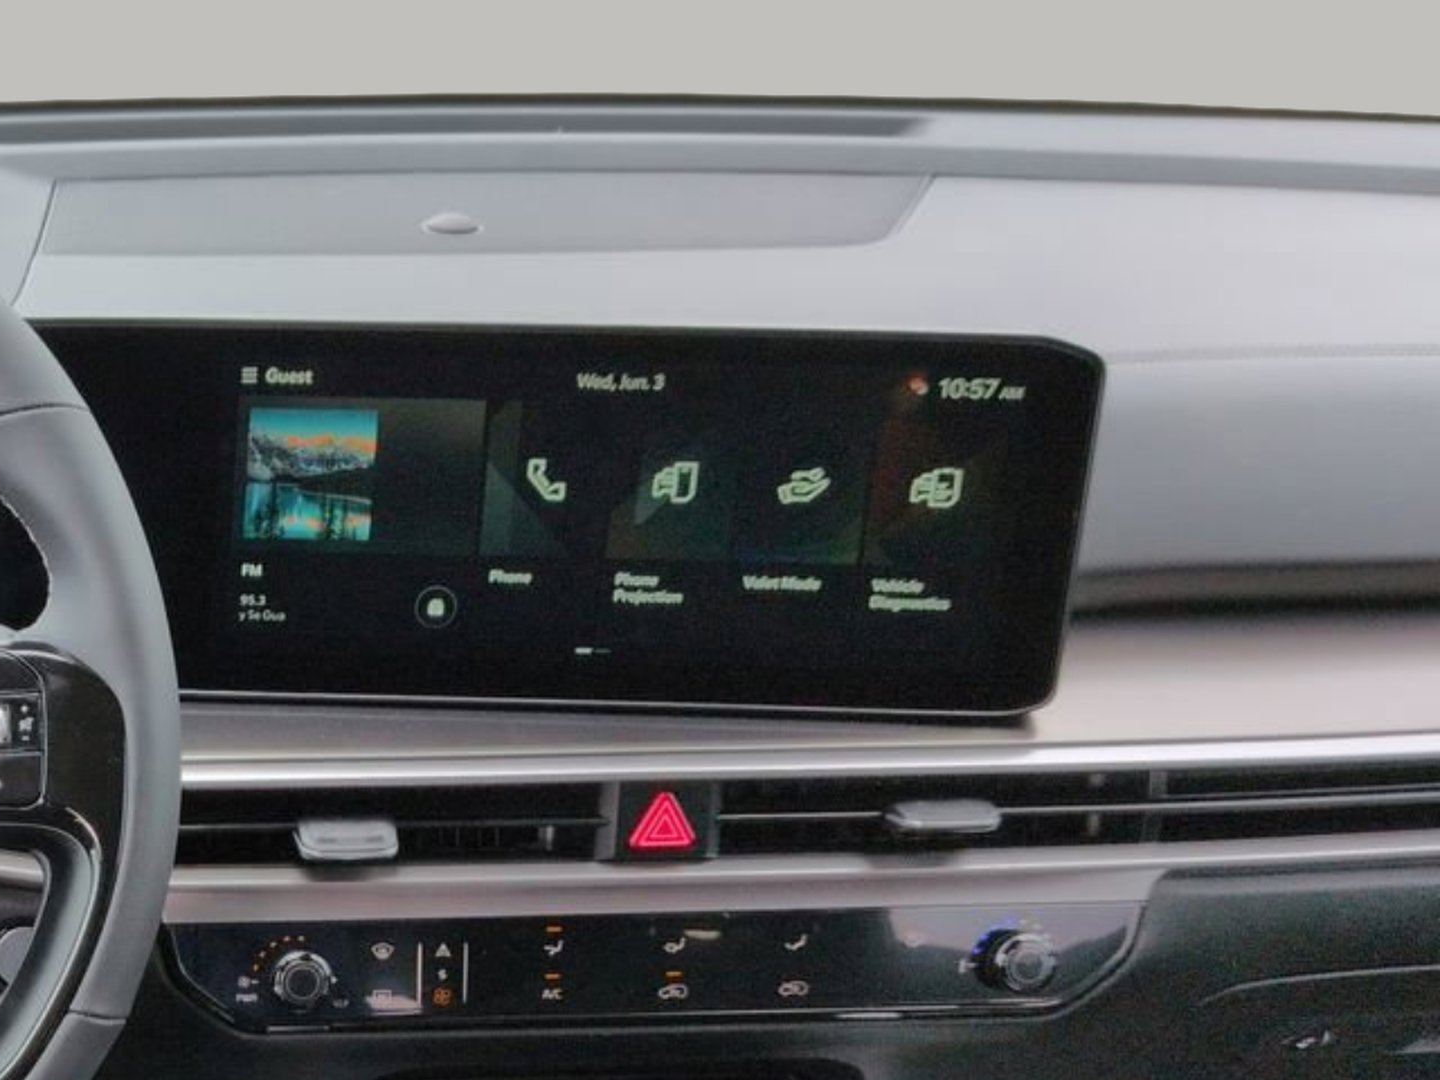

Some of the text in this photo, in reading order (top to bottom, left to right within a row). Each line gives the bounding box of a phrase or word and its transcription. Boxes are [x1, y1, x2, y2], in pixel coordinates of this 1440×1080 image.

[265, 367, 314, 386] Guest
[577, 372, 616, 392] Wed,
[652, 373, 666, 390] 3
[938, 376, 1026, 401] 10:57 AM
[240, 562, 263, 577] FM
[488, 569, 532, 586] Phone
